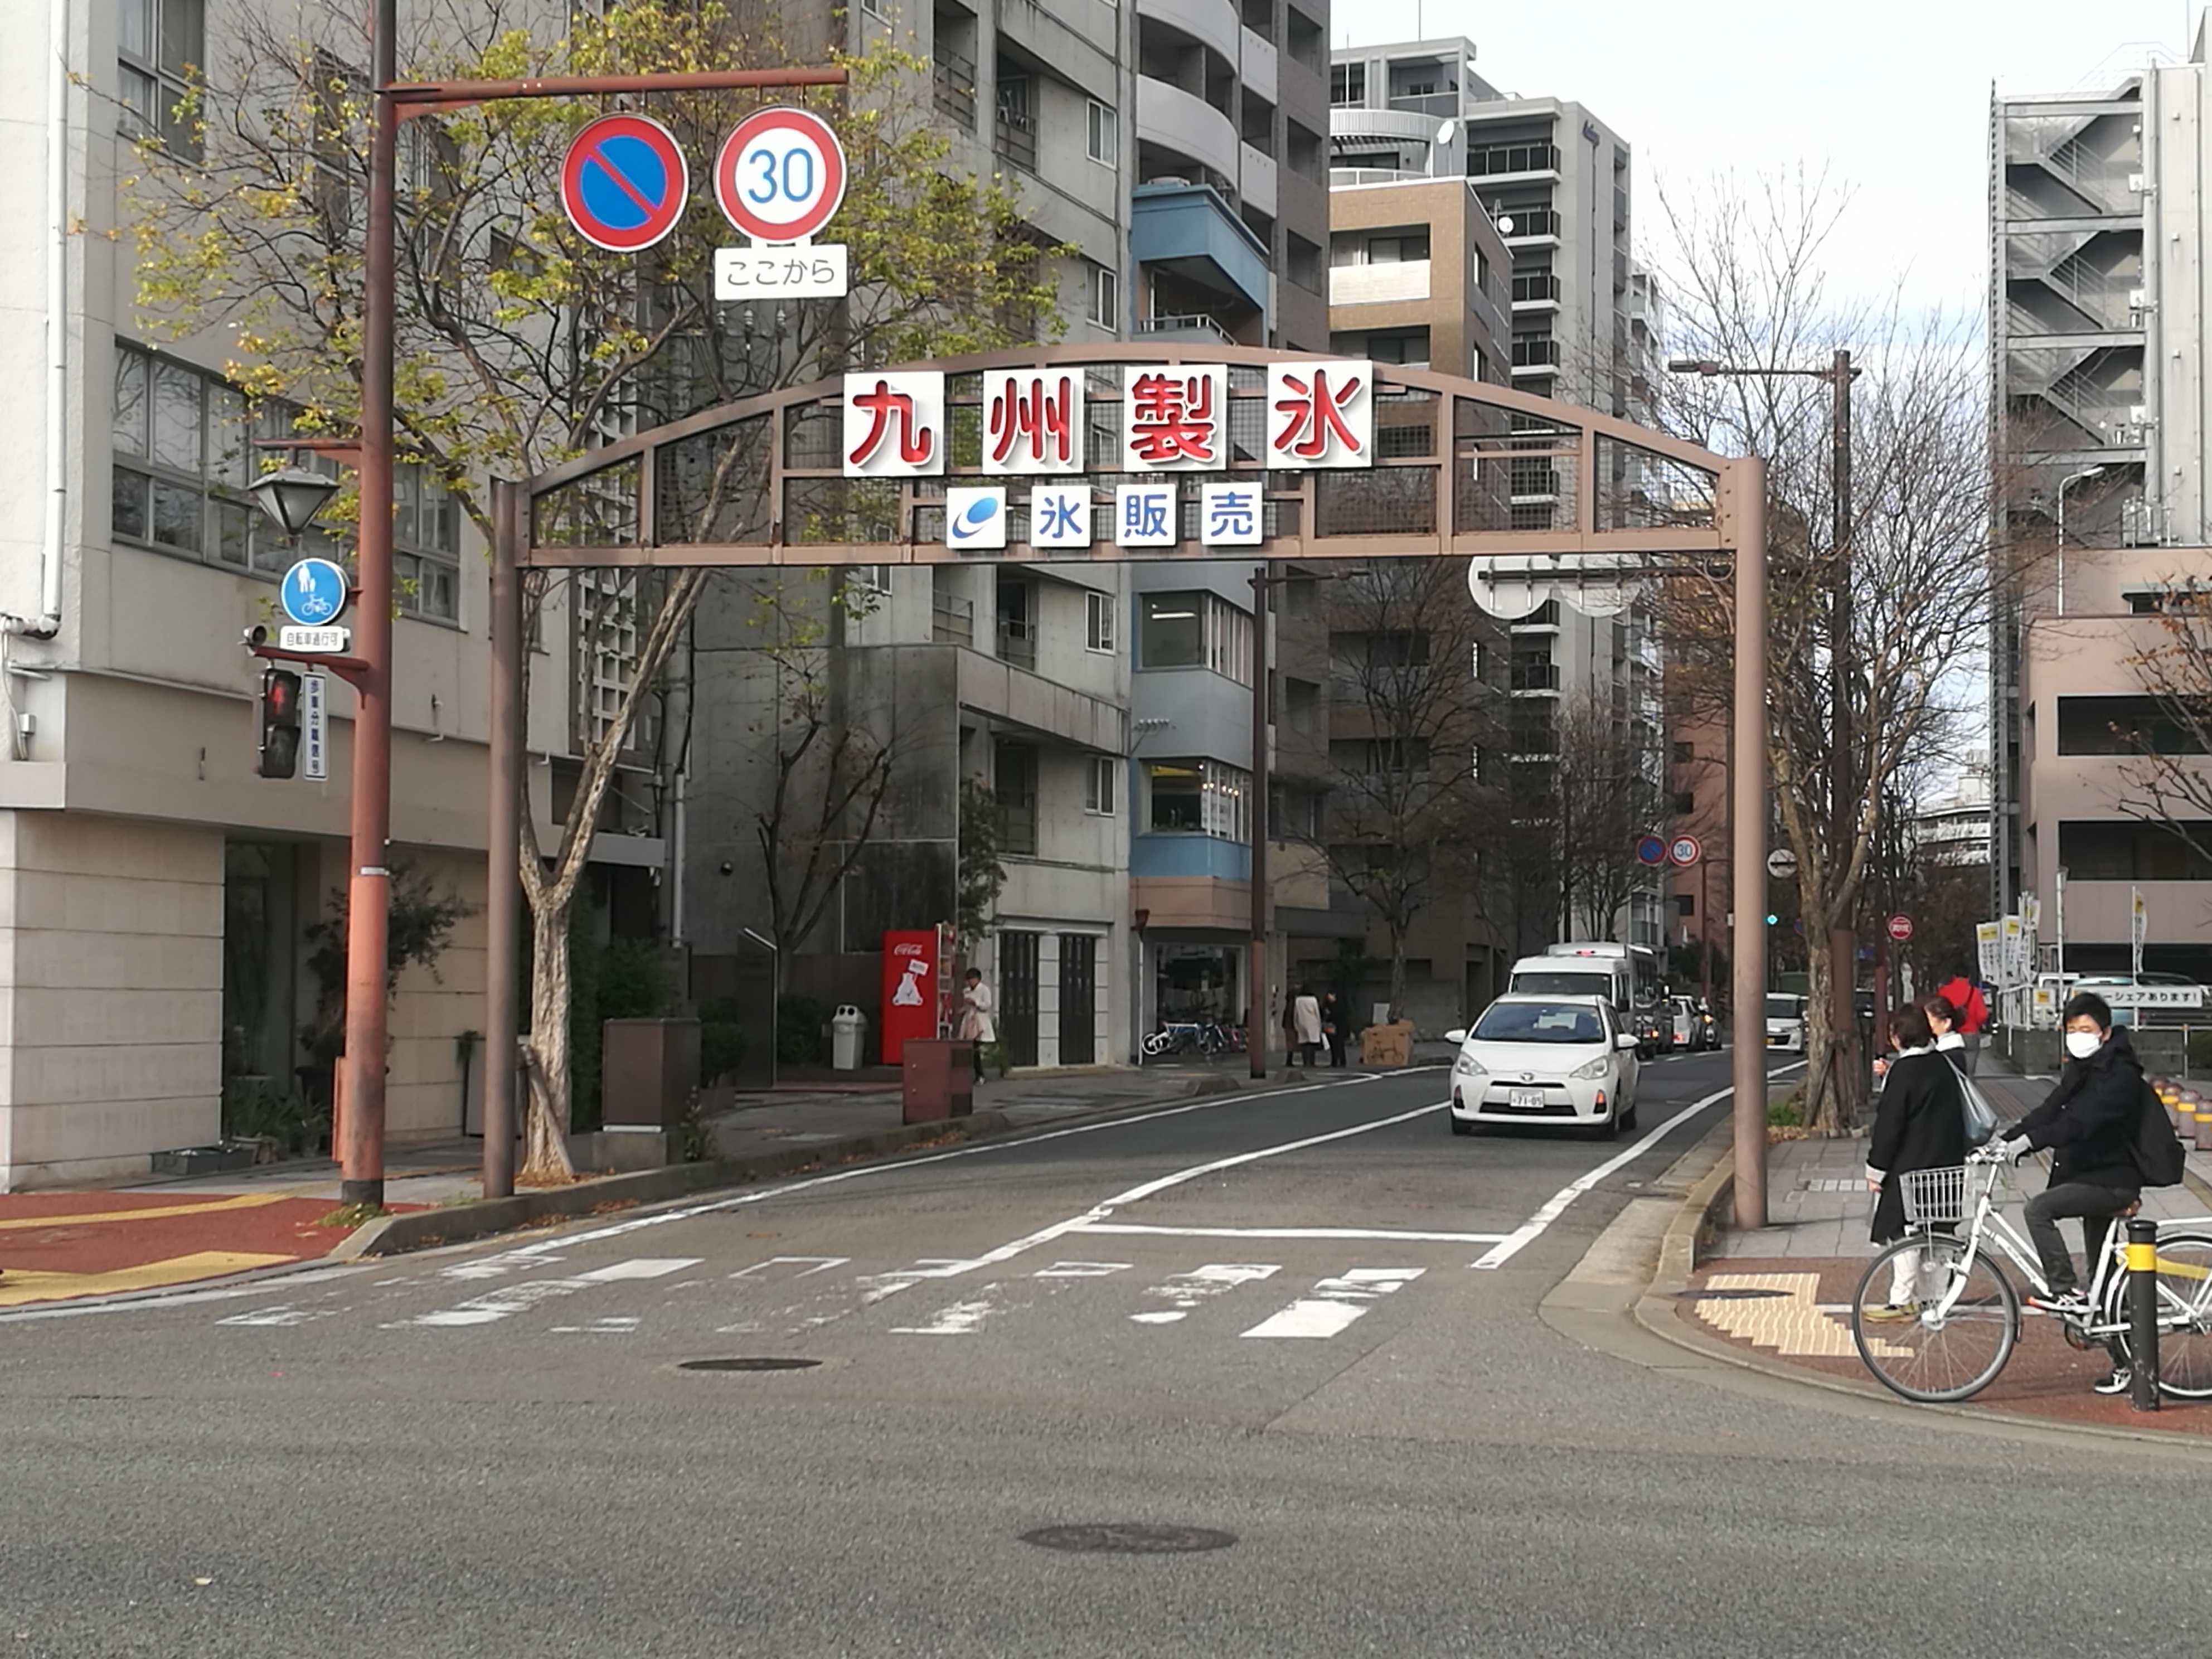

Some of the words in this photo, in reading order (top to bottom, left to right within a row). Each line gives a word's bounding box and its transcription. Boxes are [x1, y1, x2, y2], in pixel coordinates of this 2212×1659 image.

[748, 148, 813, 204] 30
[727, 258, 835, 286] ここから
[848, 368, 1361, 465] 九州製氷
[1039, 491, 1254, 539] 氷販売
[1676, 843, 1693, 857] 30
[2103, 991, 2198, 1001] ーシェアあります!
